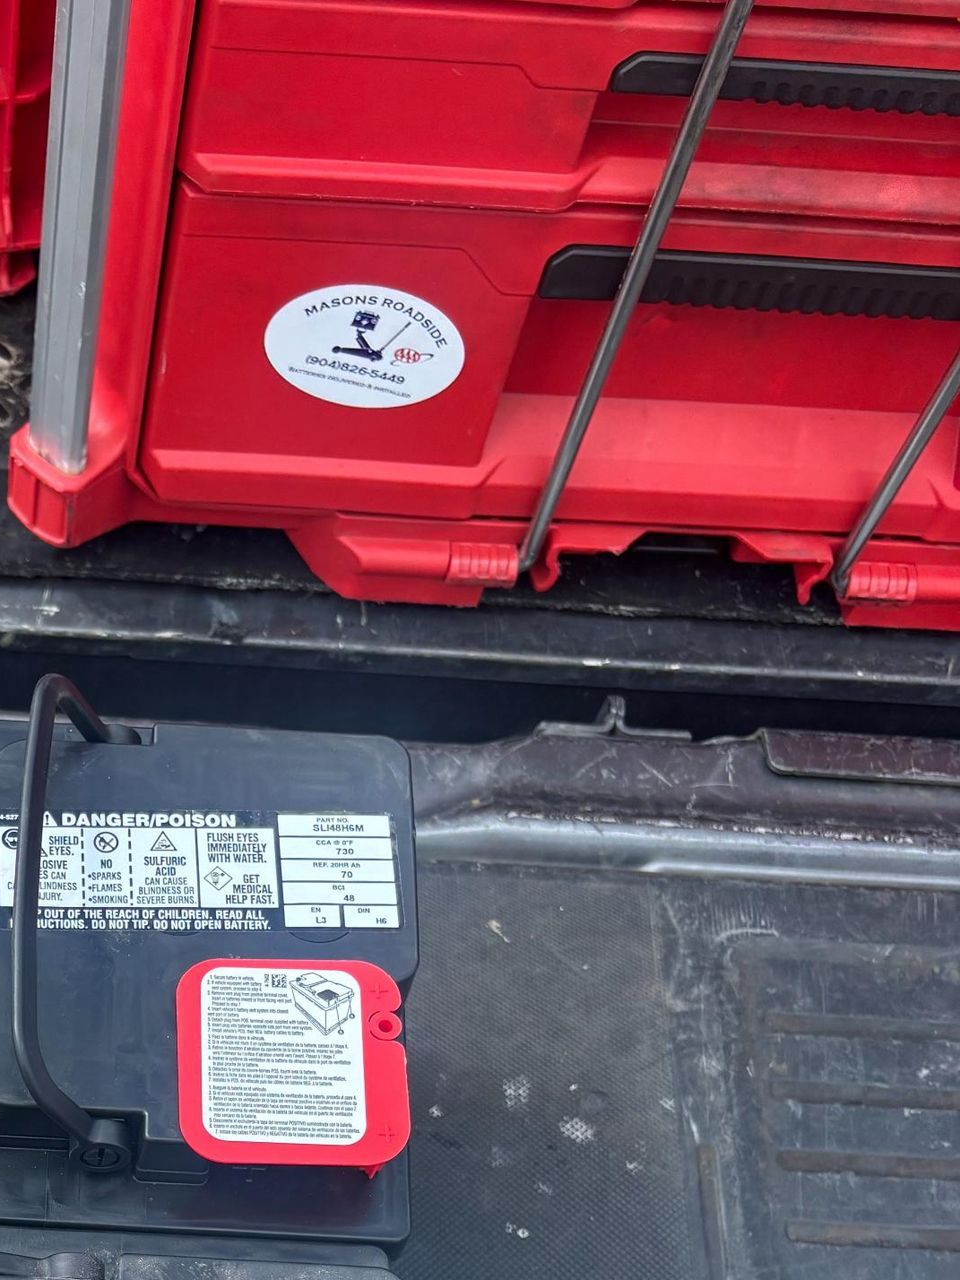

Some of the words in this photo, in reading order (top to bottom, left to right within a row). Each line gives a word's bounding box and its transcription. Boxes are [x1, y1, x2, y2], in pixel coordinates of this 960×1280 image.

[305, 296, 378, 316] MASONS
[382, 298, 448, 349] ROADSIDE
[305, 355, 405, 384] (904)826-5449
[62, 813, 236, 827] DANGER/POISON
[49, 836, 79, 845] SHIELD
[207, 833, 234, 842] FLUSH
[237, 833, 258, 842] EYES
[49, 846, 74, 855] EYES.
[208, 843, 266, 852] IMMEDIATELY
[144, 857, 186, 865] SULFURIC
[208, 854, 230, 862] WITH
[233, 854, 267, 863] WATER.
[101, 860, 112, 868] NO
[155, 867, 176, 876] ACID
[243, 875, 260, 883] GET
[139, 887, 181, 895] BLINDNESS
[184, 887, 194, 895] OR
[233, 885, 272, 893] MEDICAL
[137, 896, 165, 904] SEVERE
[168, 896, 196, 904] BURNS.
[226, 895, 247, 904] HELP
[251, 895, 275, 904] FAST.
